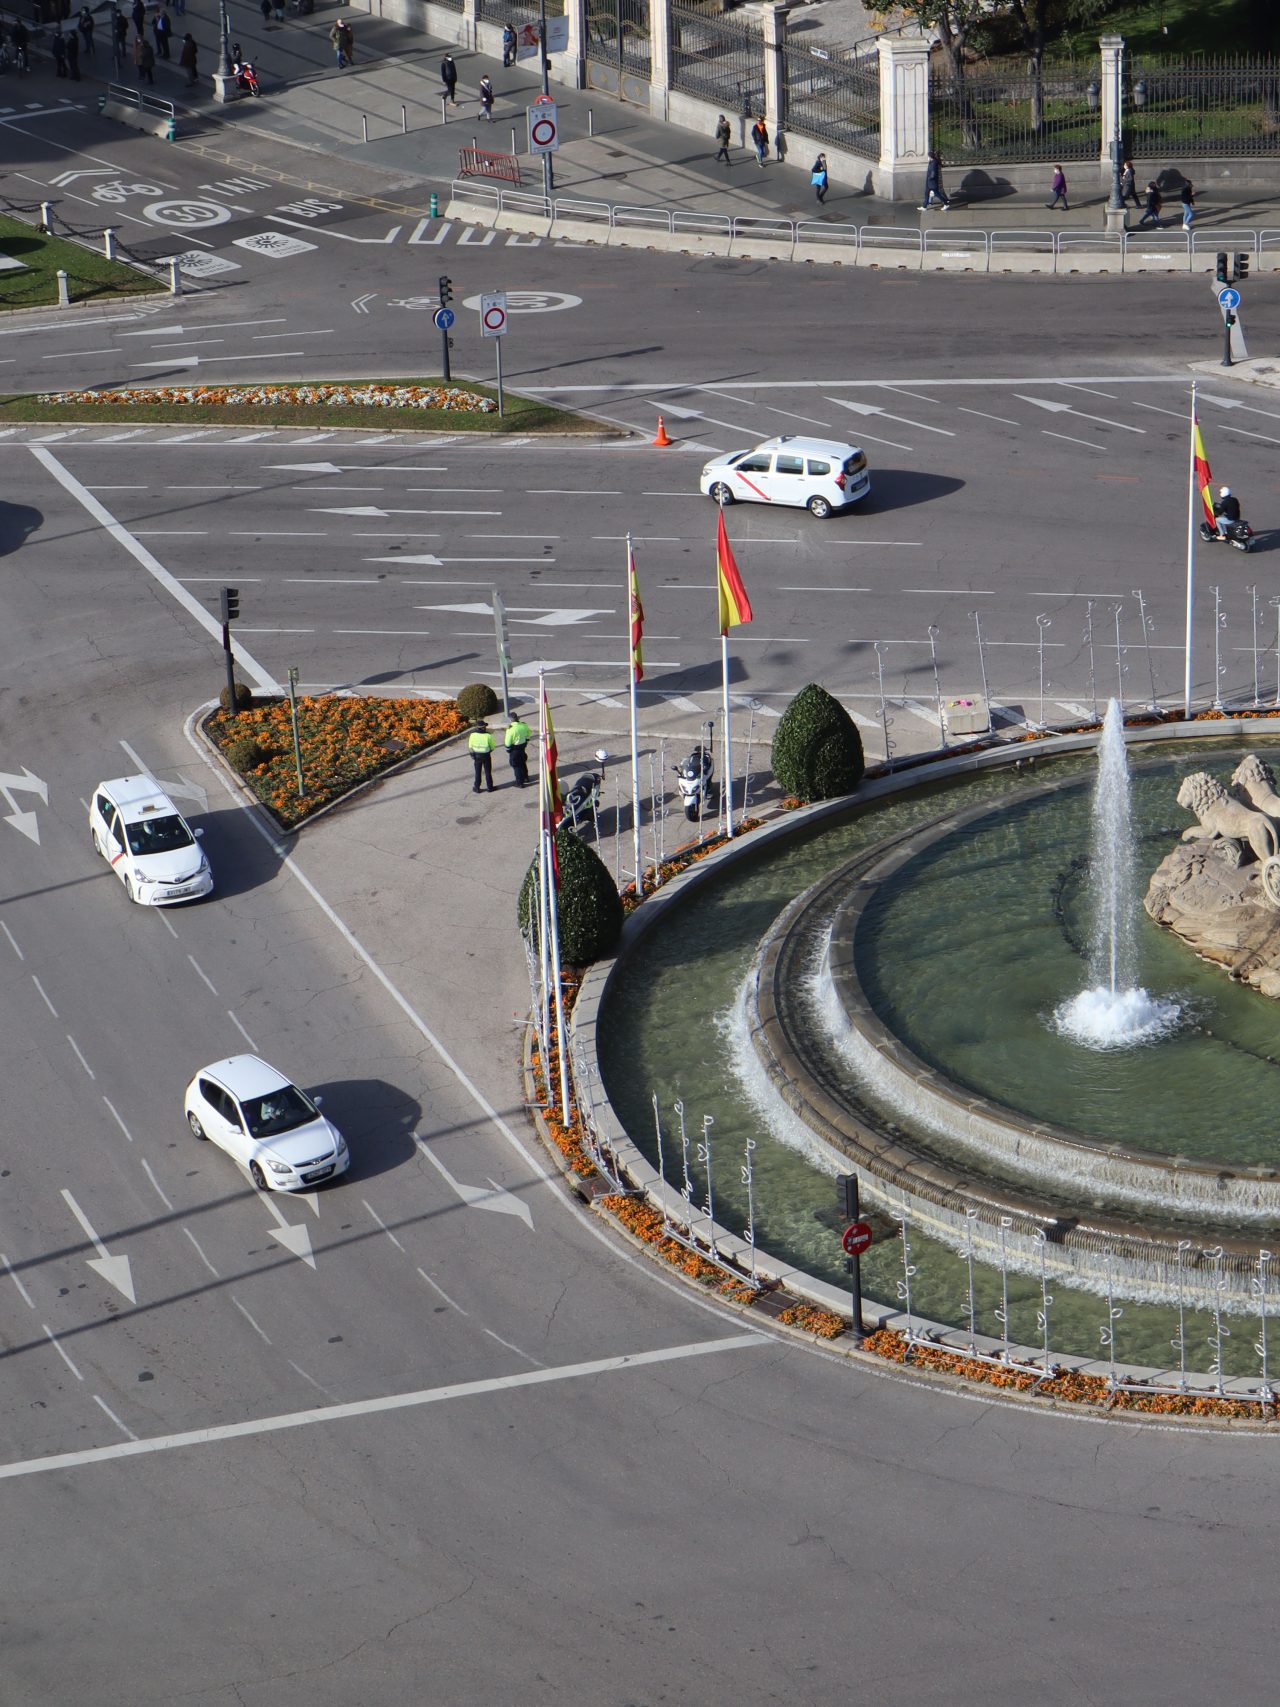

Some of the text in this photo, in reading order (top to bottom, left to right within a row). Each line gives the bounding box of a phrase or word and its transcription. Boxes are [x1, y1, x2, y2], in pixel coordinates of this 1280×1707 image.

[197, 176, 273, 197] TAXI
[162, 205, 215, 222] 30
[275, 198, 344, 218] BUS
